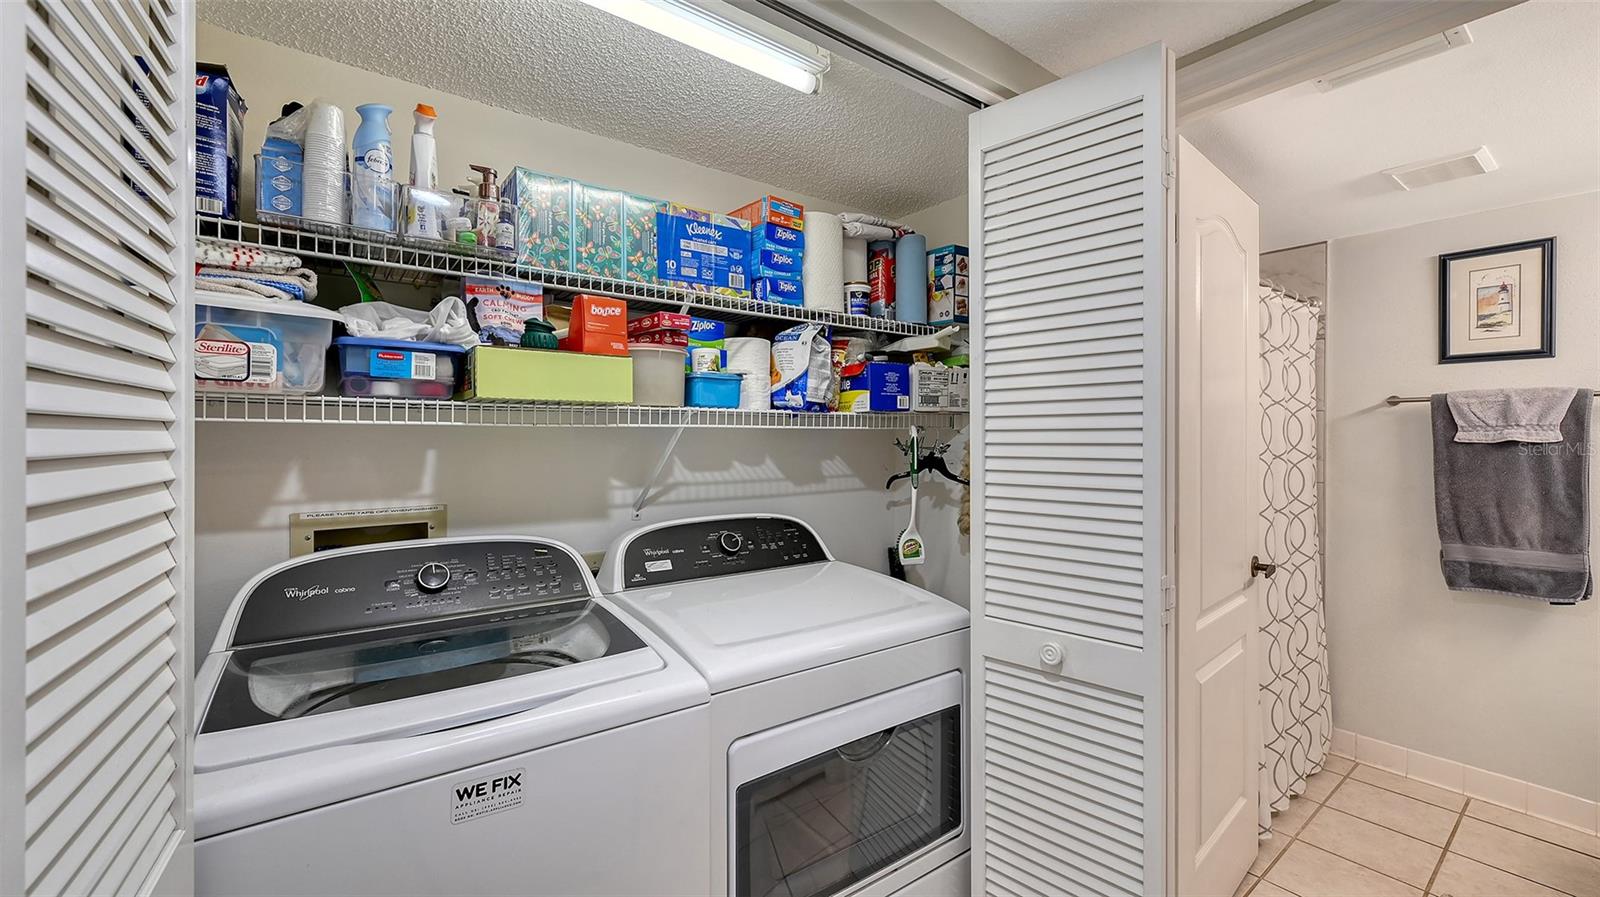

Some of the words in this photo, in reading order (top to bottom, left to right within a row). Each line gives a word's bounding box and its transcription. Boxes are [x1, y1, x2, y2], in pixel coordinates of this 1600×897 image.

[686, 222, 722, 240] Kleenex
[777, 229, 797, 241] Ziploc
[665, 260, 677, 269] 10
[773, 253, 793, 265] Ziploc
[779, 281, 797, 293] Ziploc
[482, 299, 527, 312] CALMING
[591, 305, 622, 316] bounce
[483, 313, 502, 321] SOFT
[504, 315, 523, 326] CHEW
[691, 320, 717, 332] Ziploc
[199, 341, 242, 354] Sterilite
[285, 586, 329, 600] Whirlpool
[455, 782, 487, 801] WE
[492, 773, 521, 793] FIX
[455, 796, 494, 809] APPLIANCE
[497, 788, 521, 798] REPAIR
